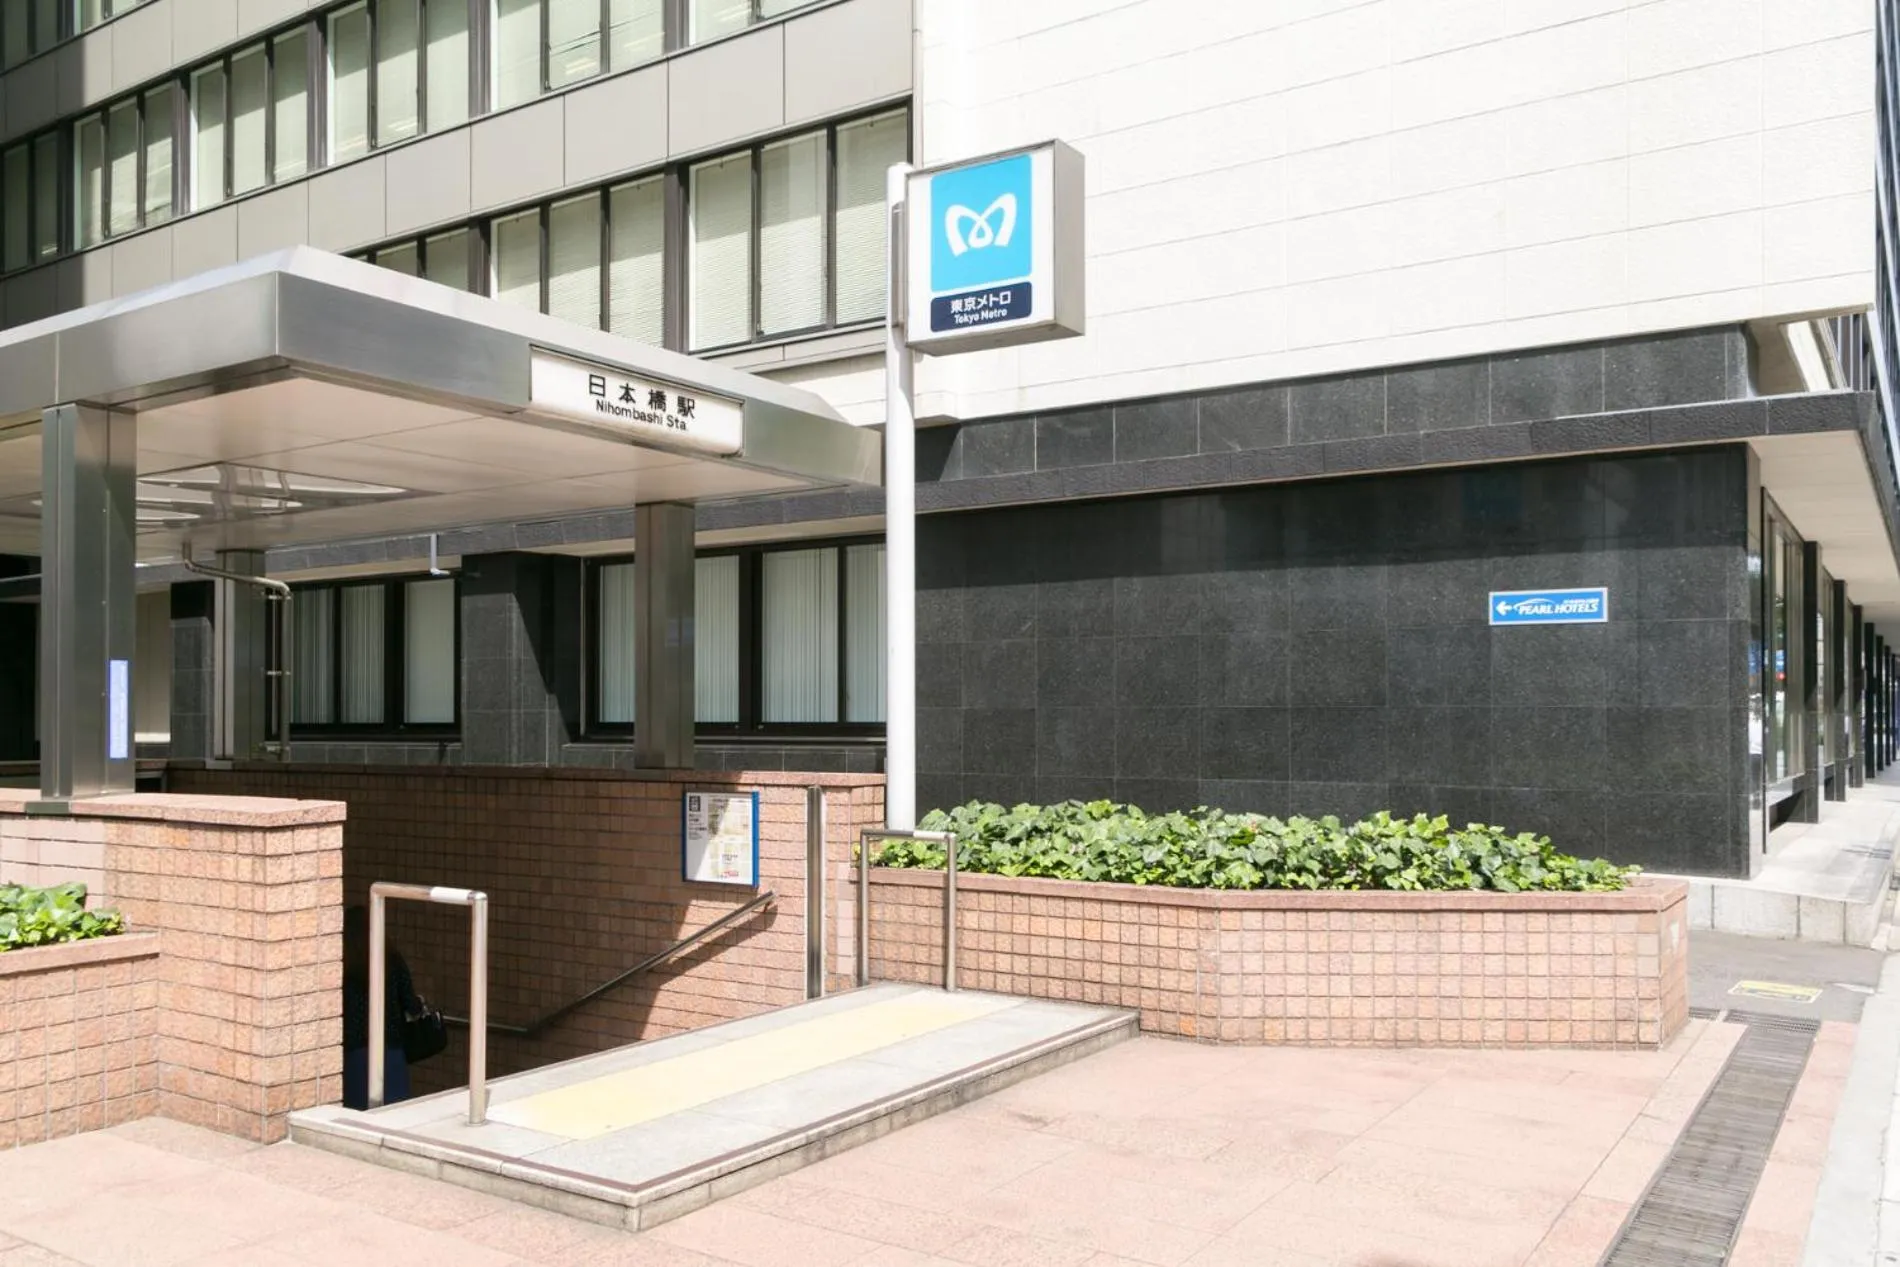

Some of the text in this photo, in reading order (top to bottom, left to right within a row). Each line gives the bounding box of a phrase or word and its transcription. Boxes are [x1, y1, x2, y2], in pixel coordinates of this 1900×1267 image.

[951, 291, 1010, 314] 東京メトロ
[954, 308, 1007, 325] Tokyo Metro
[589, 374, 696, 419] 日本橋駅
[596, 399, 663, 425] Nihombashi
[1518, 602, 1599, 615] PEARL HOTELS
